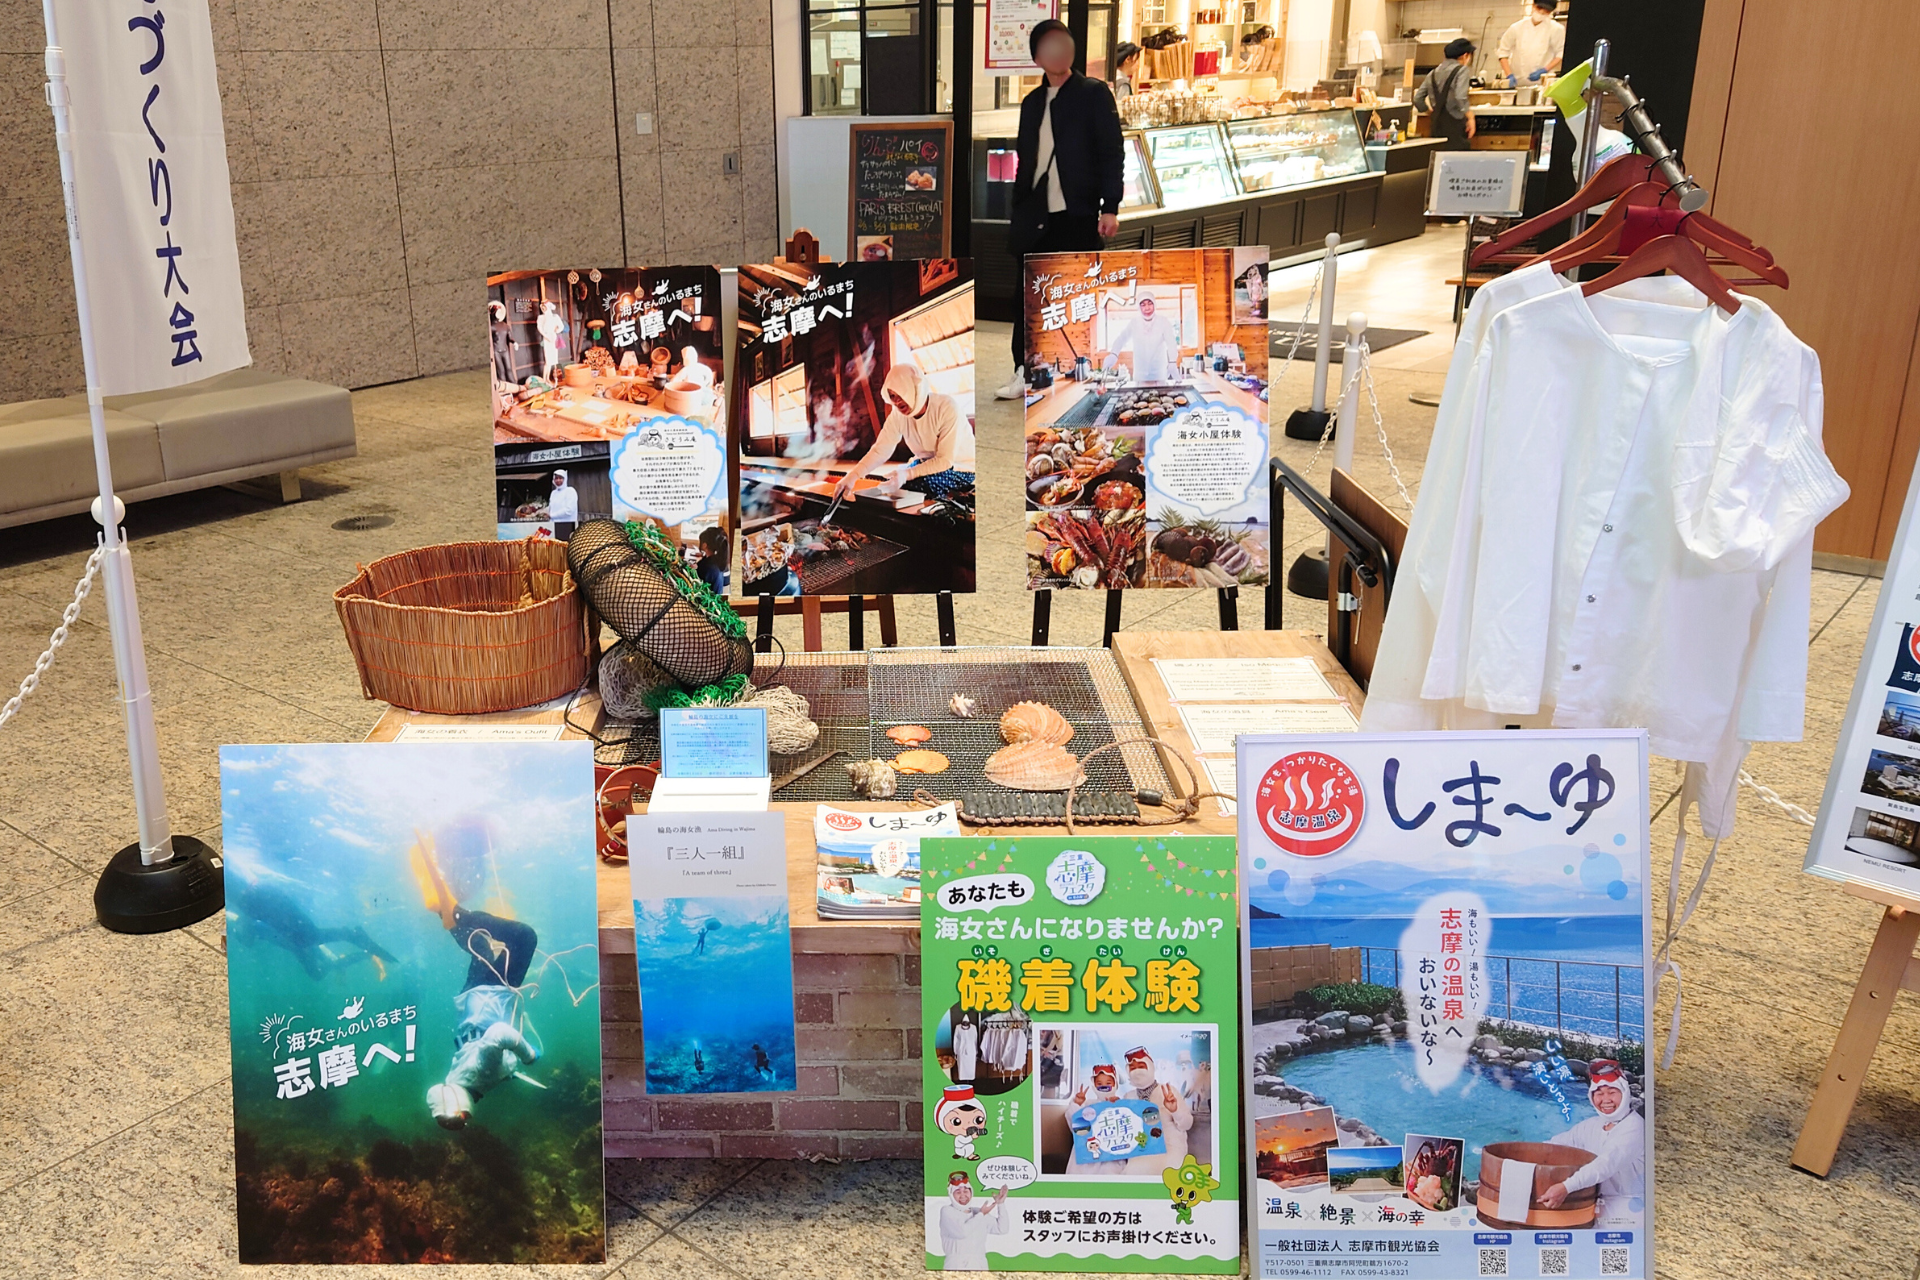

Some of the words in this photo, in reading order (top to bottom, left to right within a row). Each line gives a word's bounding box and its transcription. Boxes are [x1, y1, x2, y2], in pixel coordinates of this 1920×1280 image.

[128, 0, 202, 367] づくり大会
[770, 280, 854, 313] 海女さんのいるまち
[1050, 266, 1137, 300] 海女さんのいるまち
[620, 284, 702, 317] 海女さんのいるまち
[1041, 279, 1137, 332] 志摩へ!
[611, 297, 702, 348] 志摩へ!
[761, 292, 854, 344] 志摩へ!
[1177, 429, 1242, 440] 海女小屋体験
[1279, 808, 1342, 829] 志摩温泉
[666, 845, 745, 860] 『三人一組』
[1863, 858, 1881, 867] NEMU
[1882, 863, 1907, 874] RESORT
[948, 880, 1026, 905] あなたも
[934, 916, 1224, 941] 海女さんになりませんか?
[974, 946, 997, 956] いそ
[1042, 946, 1051, 956] ぎ
[1099, 946, 1121, 956] たい
[1162, 946, 1185, 956] けん
[957, 958, 1201, 1014] 磯着体験
[1440, 907, 1465, 1039] 志摩の温泉へ
[286, 1005, 417, 1053] 海女さんのいるまち
[273, 1024, 417, 1100] 志摩へ!
[987, 1164, 1028, 1172] ぜひ体験して
[1022, 1209, 1143, 1225] 体験ご希望の方は
[1022, 1228, 1217, 1245] スタッフにお声掛けください。
[1265, 1239, 1343, 1252] 一般社団法人
[1348, 1239, 1440, 1253] 志摩市観光協会
